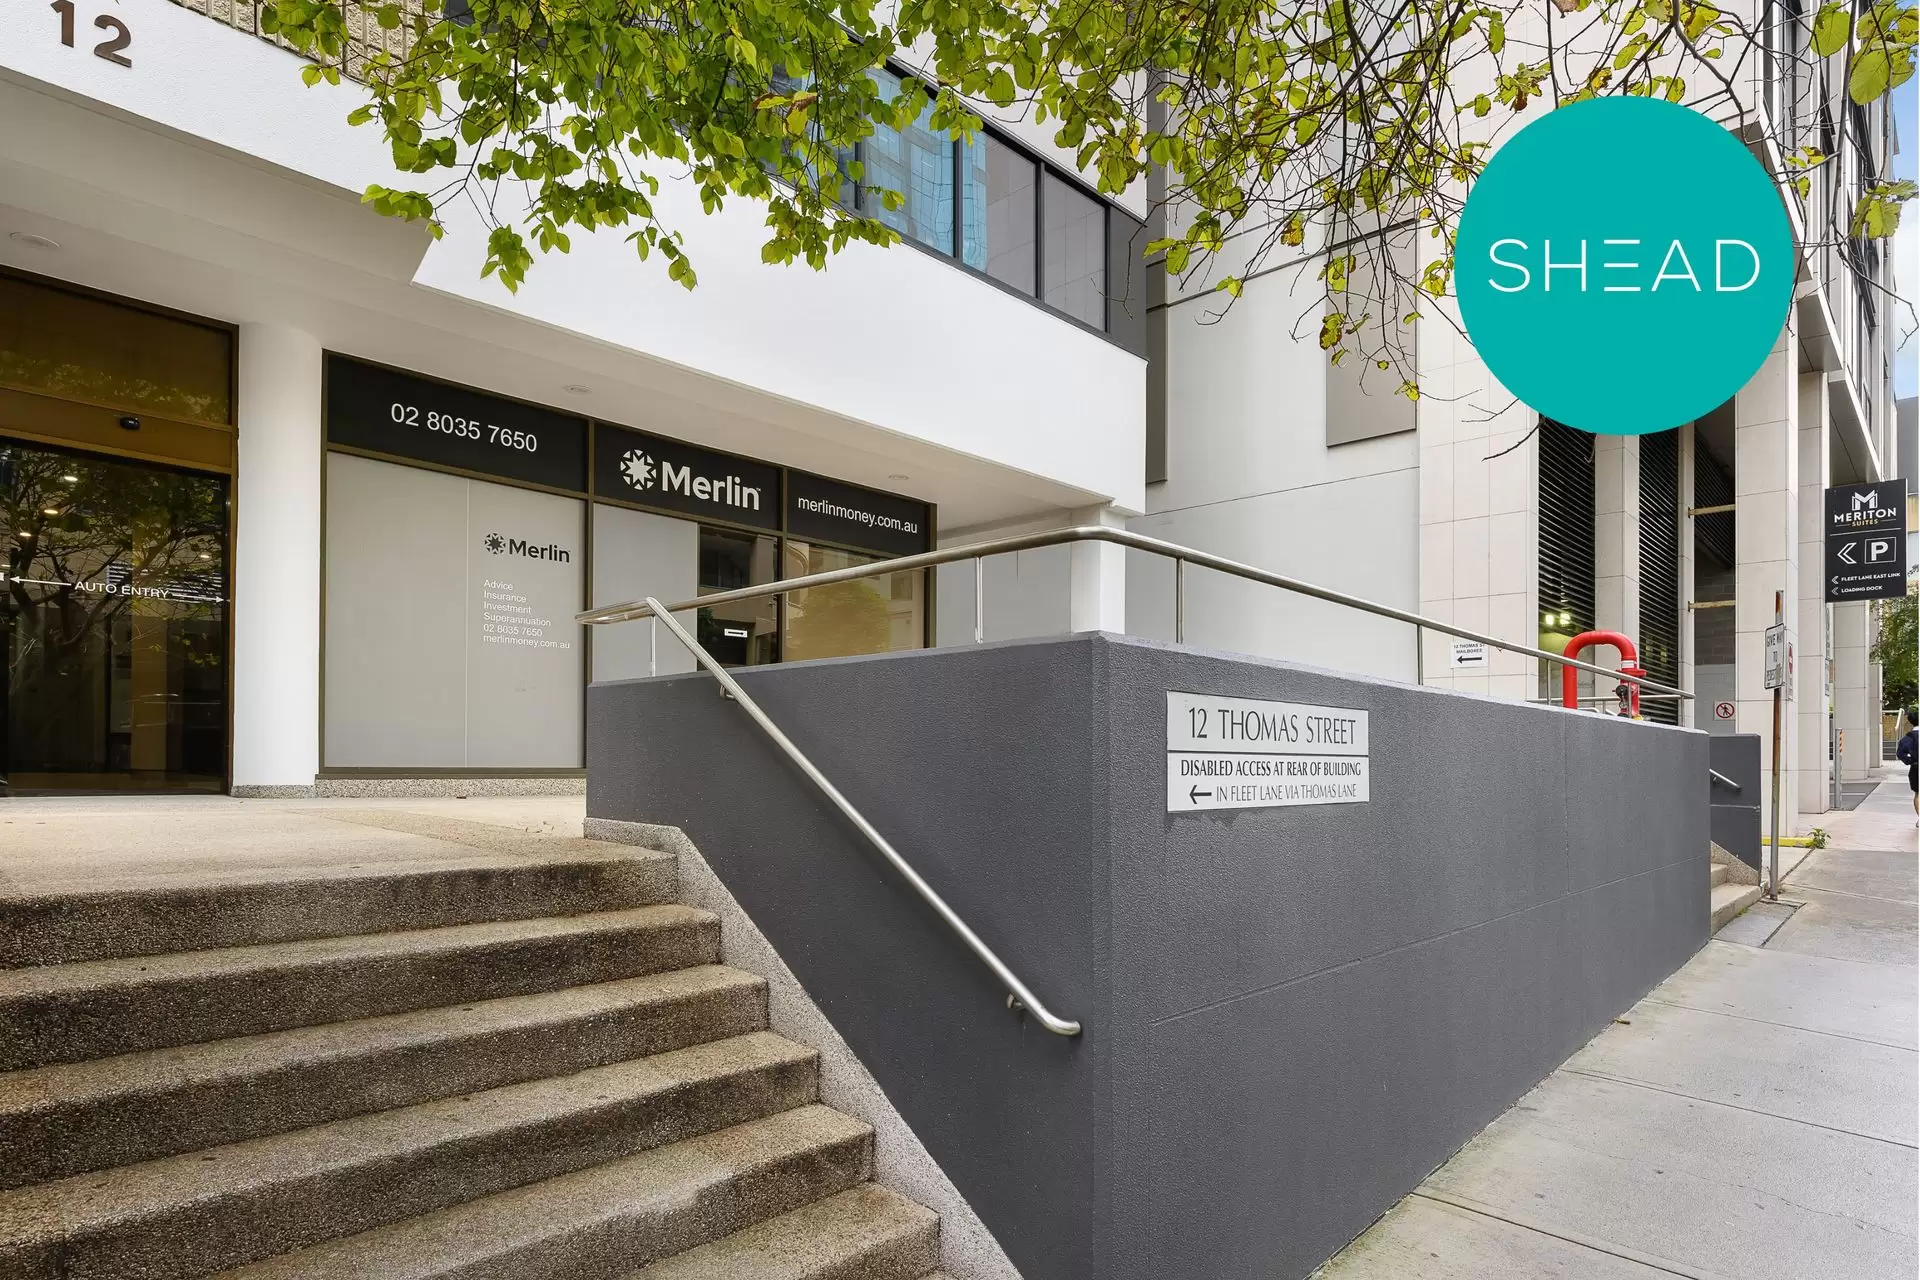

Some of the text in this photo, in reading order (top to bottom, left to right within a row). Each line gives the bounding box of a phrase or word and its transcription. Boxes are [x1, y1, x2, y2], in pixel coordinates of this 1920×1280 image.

[49, 0, 132, 68] 12
[391, 403, 538, 452] 02 8035 7650
[797, 496, 918, 534] merlinmoney.com.au
[1834, 507, 1897, 523] MERITON
[1852, 519, 1879, 527] SUITES
[509, 538, 571, 563] Merlin
[1871, 541, 1889, 561] P
[74, 581, 170, 599] AUTO ENTRY
[484, 580, 513, 591] Advice
[484, 590, 527, 603] Insurance
[484, 601, 531, 614] Investment
[484, 612, 551, 627] Superannuation
[484, 624, 543, 637] 02 8035 7650
[483, 634, 571, 649] merlinmoney.com.au
[1189, 707, 1356, 744] 12 THOMAS STREET
[1181, 759, 1361, 776] DISABLED ACCESS AT REAR OF BUILDING
[1216, 784, 1357, 802] IN FLEET LANE VIA THOMAS LANE
